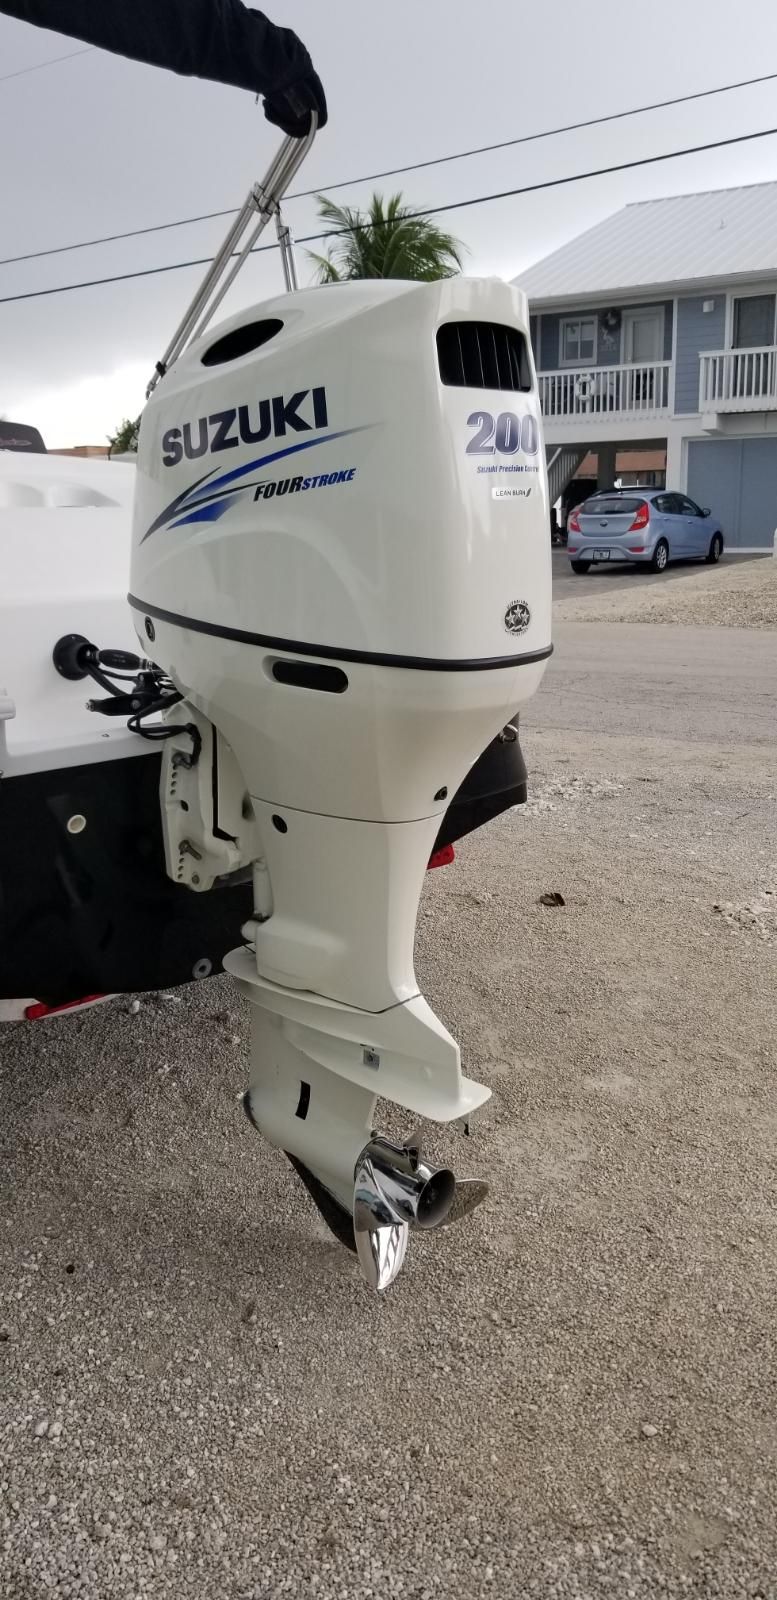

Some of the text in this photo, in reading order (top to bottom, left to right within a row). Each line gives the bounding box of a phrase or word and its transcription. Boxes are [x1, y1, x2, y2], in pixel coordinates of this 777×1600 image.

[162, 386, 328, 467] SUZUKI
[465, 411, 538, 456] 200
[477, 465, 498, 473] Suzuki
[499, 464, 524, 473] Precision
[496, 489, 511, 497] LEAN
